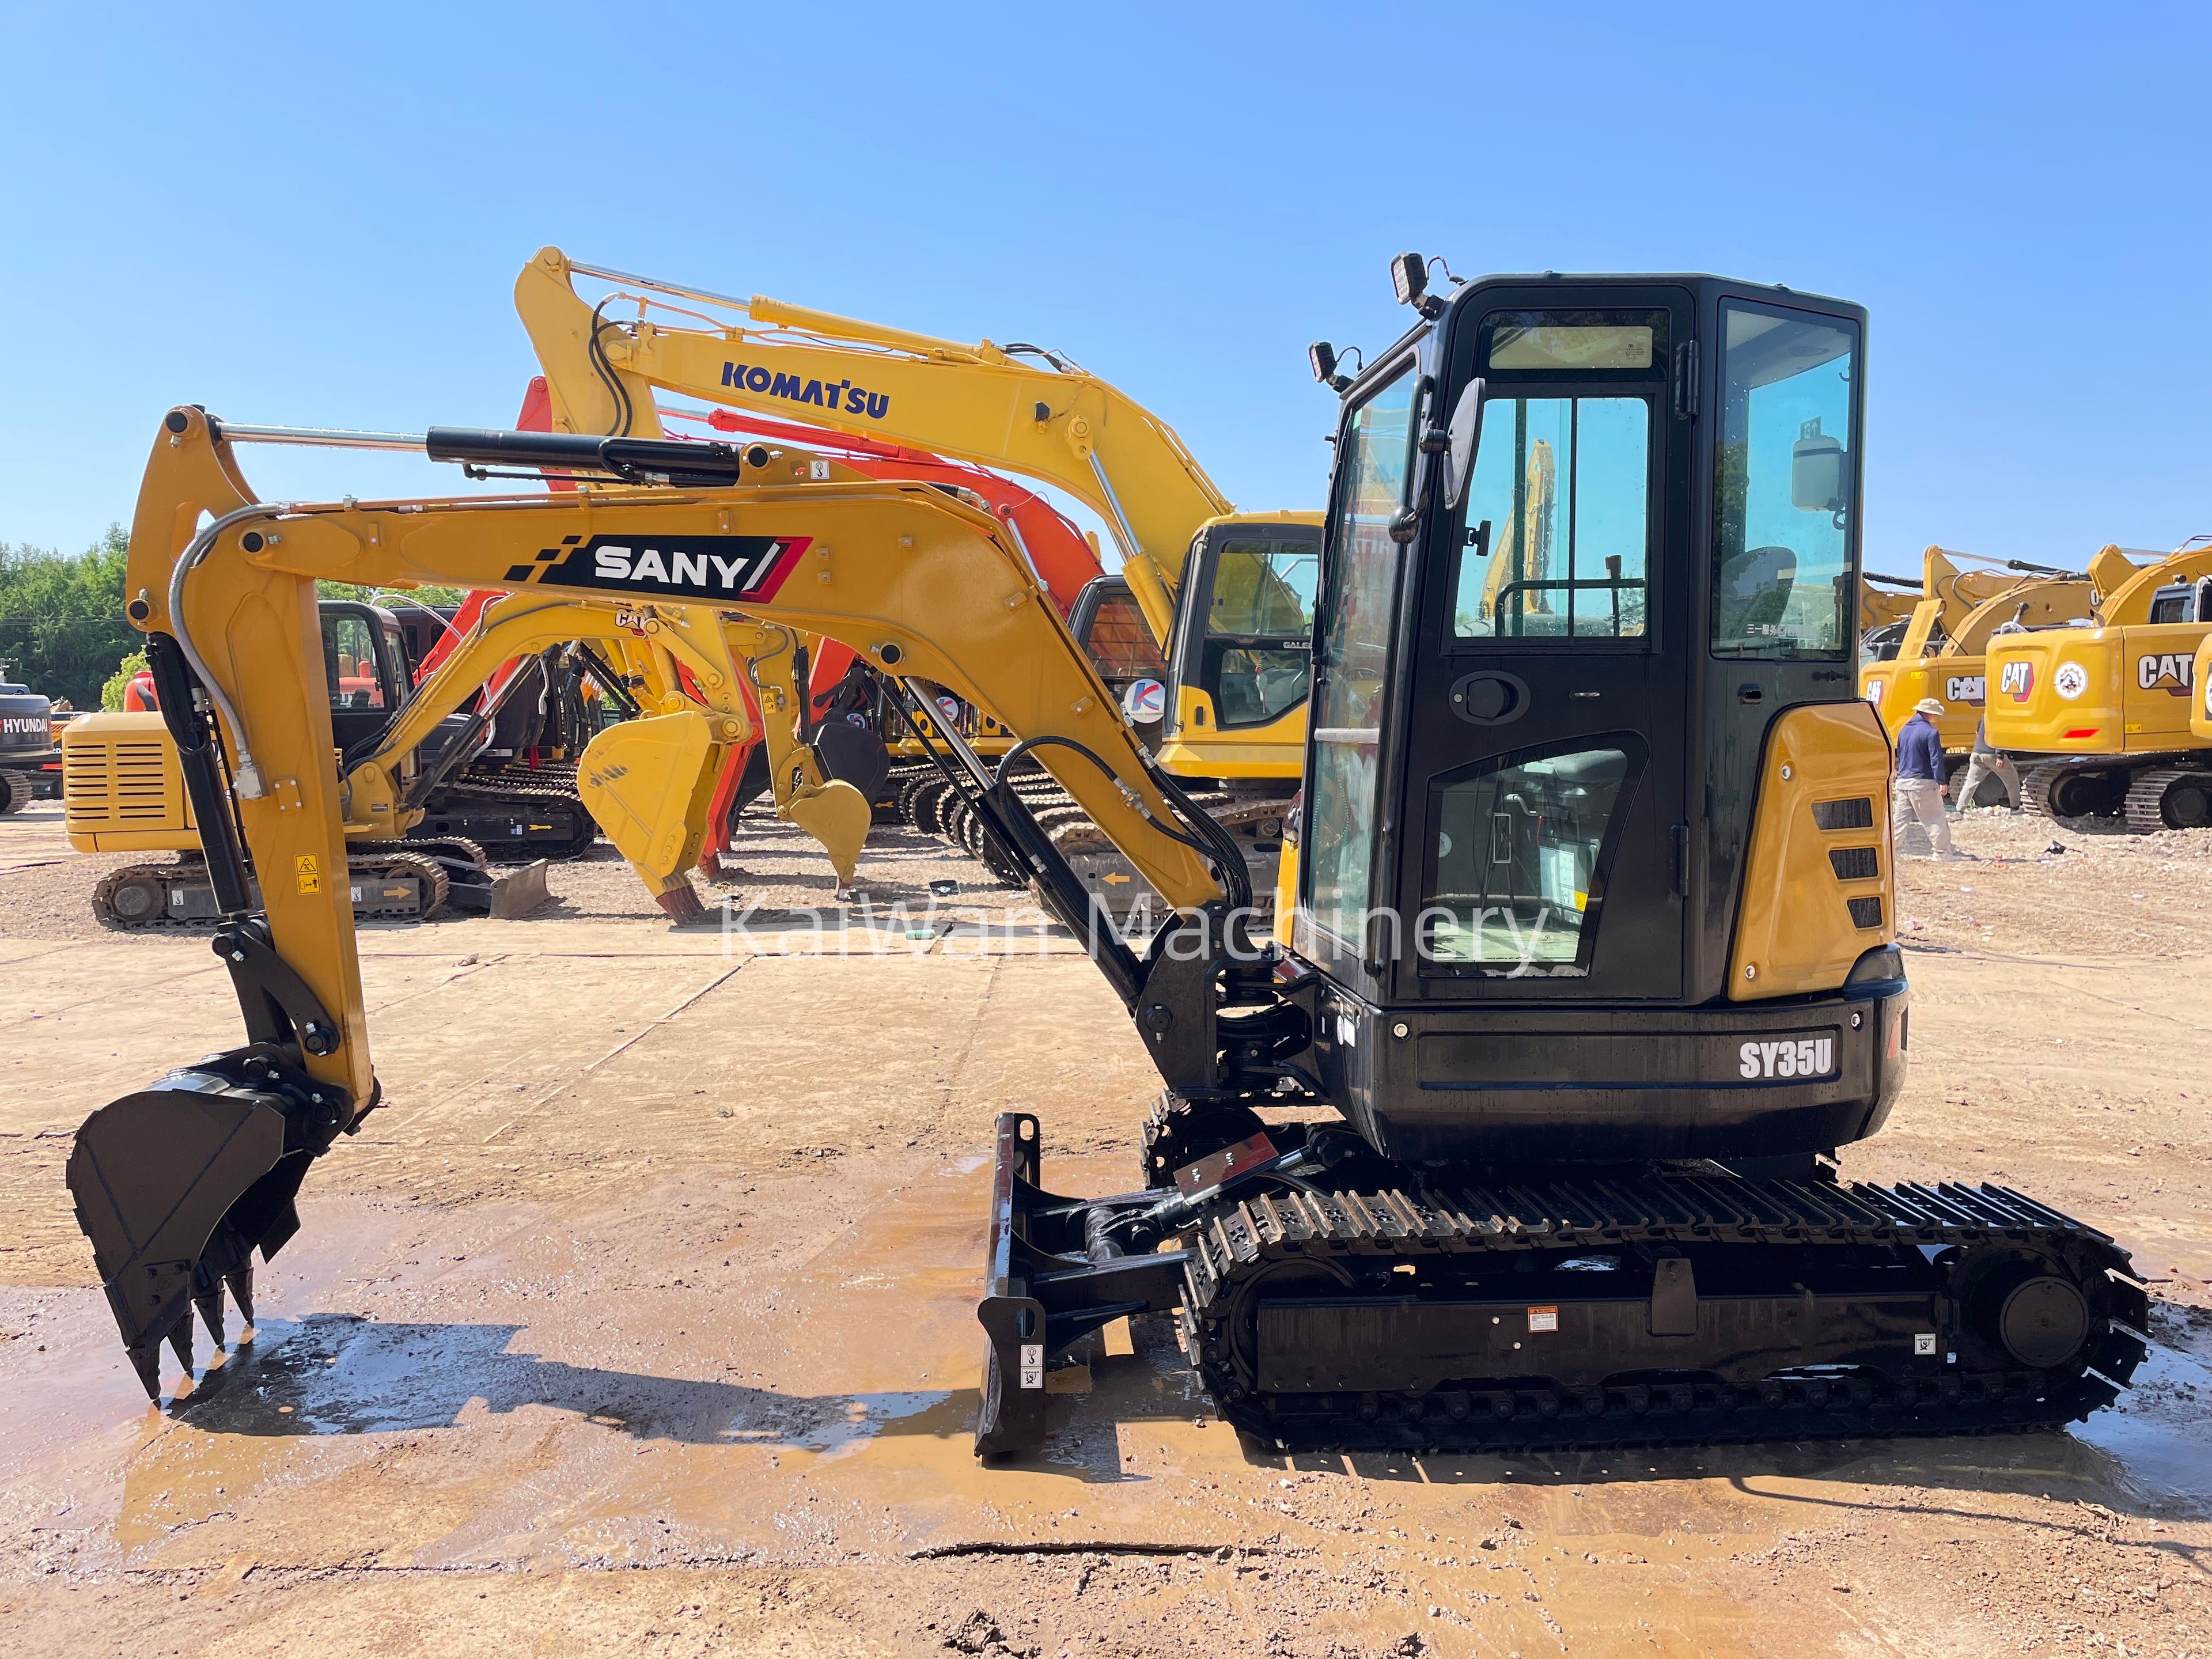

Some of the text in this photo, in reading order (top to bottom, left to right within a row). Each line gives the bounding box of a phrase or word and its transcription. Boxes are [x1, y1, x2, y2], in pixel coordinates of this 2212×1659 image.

[721, 361, 890, 419] KOMATSU
[595, 546, 749, 589] SANY
[2002, 662, 2029, 693] CAT
[2138, 654, 2193, 688] CAT
[3, 718, 48, 733] HYUNDAI
[1740, 1038, 1832, 1078] SY35U
